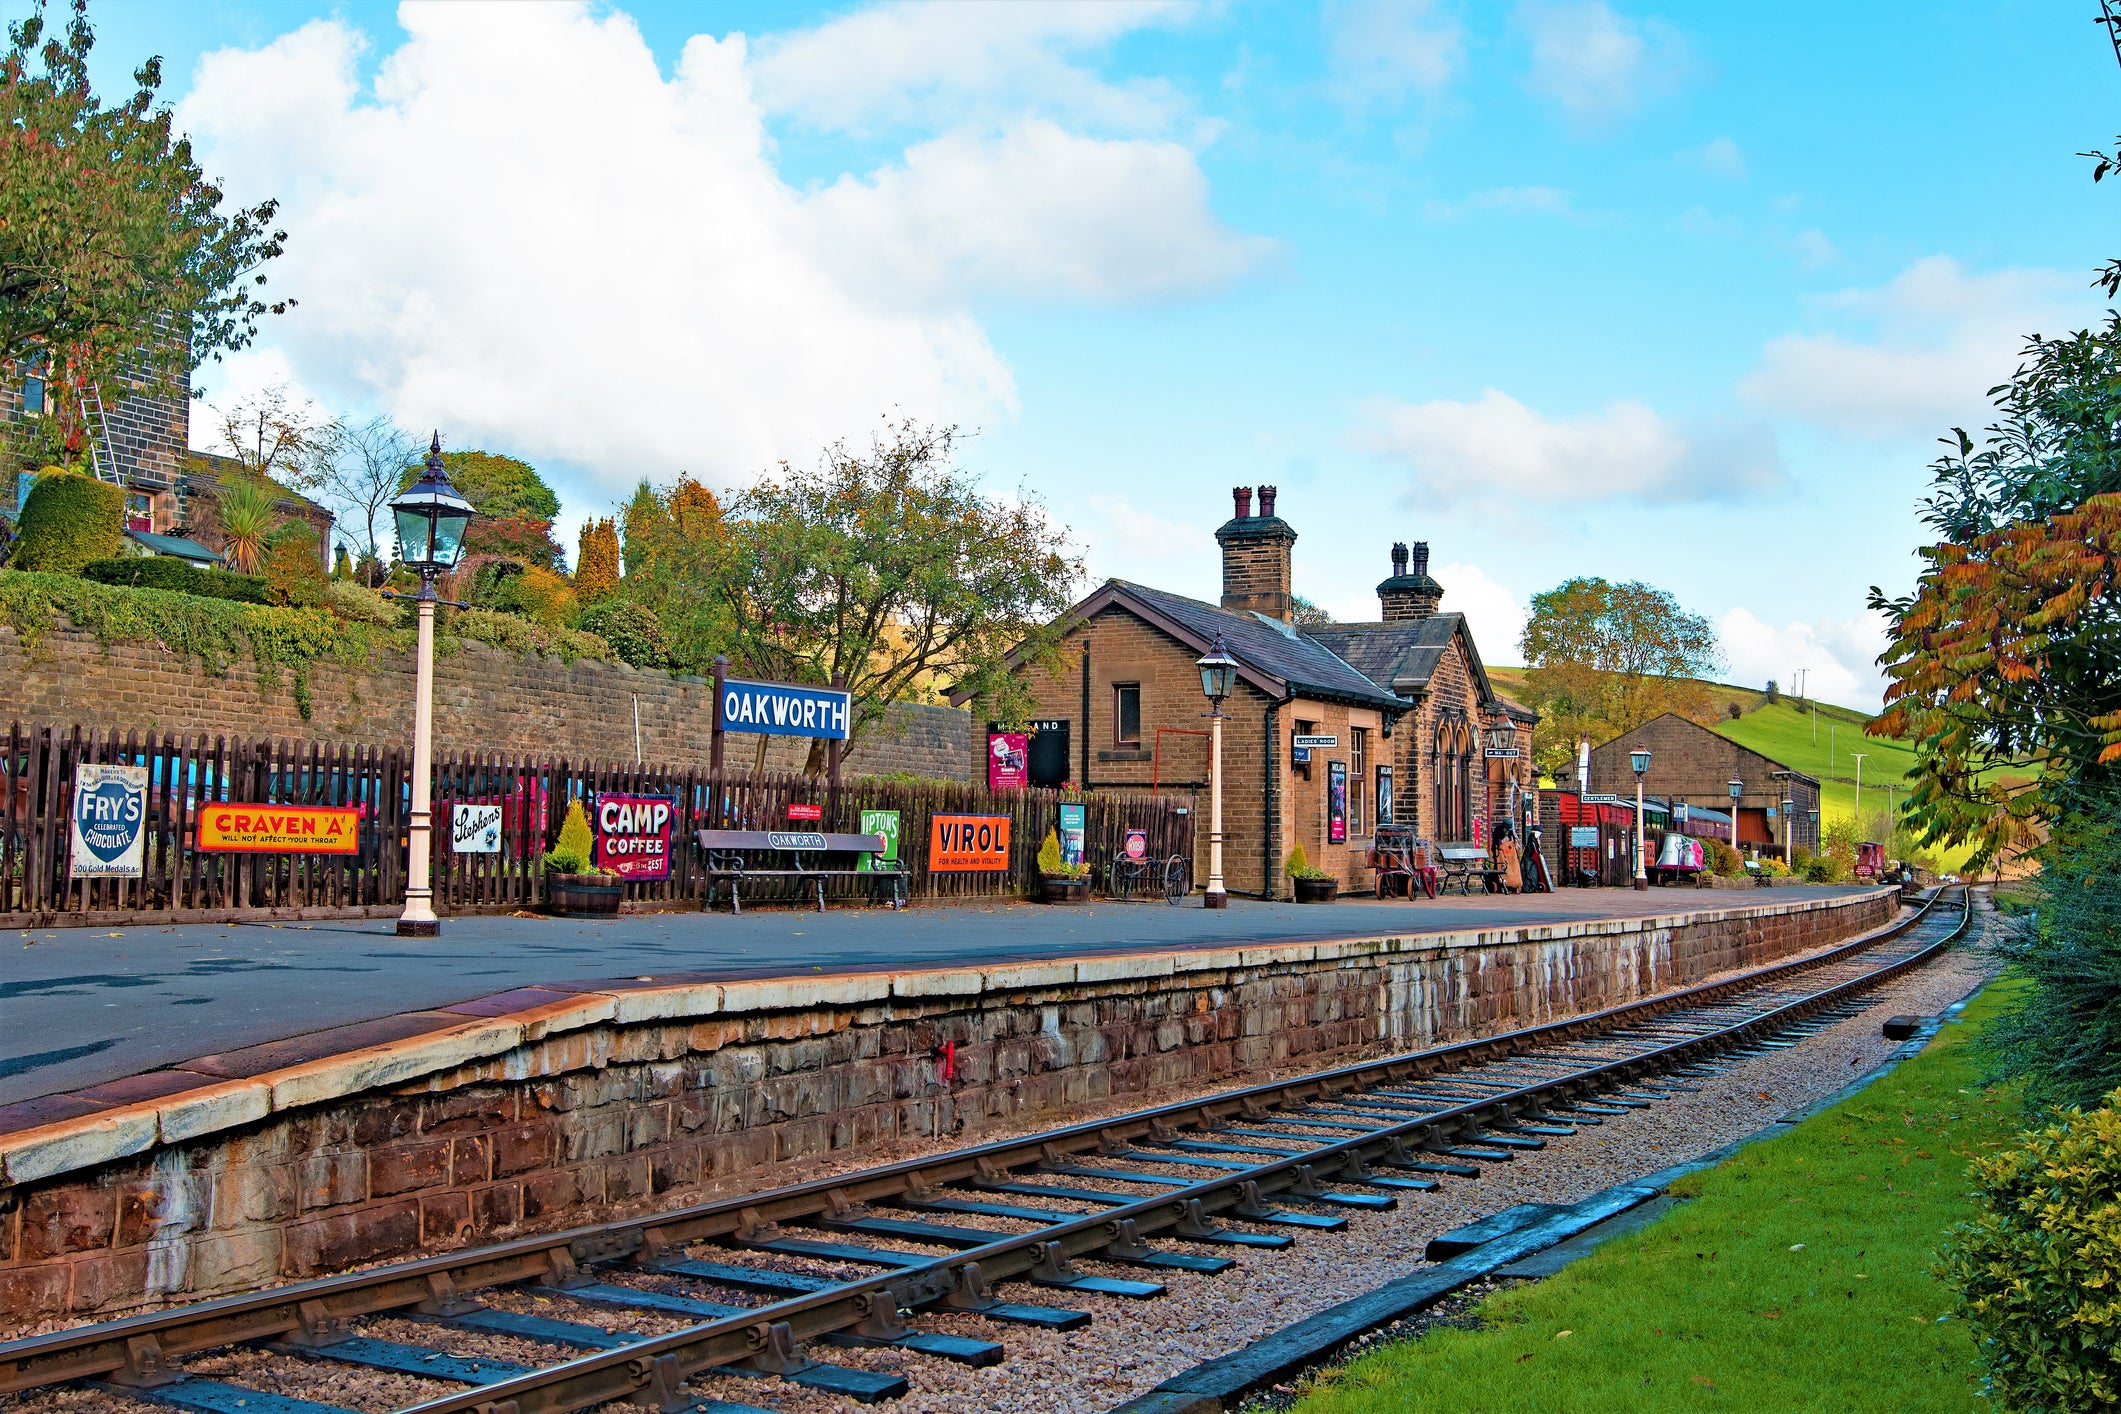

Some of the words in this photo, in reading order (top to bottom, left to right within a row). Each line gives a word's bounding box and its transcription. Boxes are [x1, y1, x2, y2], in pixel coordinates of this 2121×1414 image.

[725, 691, 846, 731] OAKWORTH
[82, 792, 140, 822] FRY'S
[93, 823, 126, 831] CELEBRATED
[215, 813, 316, 836] CRAVEN
[84, 828, 132, 849] CHOCOLATE
[222, 834, 238, 842] WILL
[241, 835, 257, 843] NOT
[259, 835, 287, 843] AFFECT
[771, 835, 822, 846] OAKWORTH
[939, 822, 1006, 854] VIROL
[606, 837, 664, 856] COFFEE
[88, 865, 104, 873] Gold
[105, 864, 130, 873] Medals
[647, 858, 664, 872] BEST
[938, 857, 949, 865] FOR
[951, 857, 969, 865] HEALTH
[969, 857, 980, 865] AND
[981, 857, 1002, 865] VITALITY
